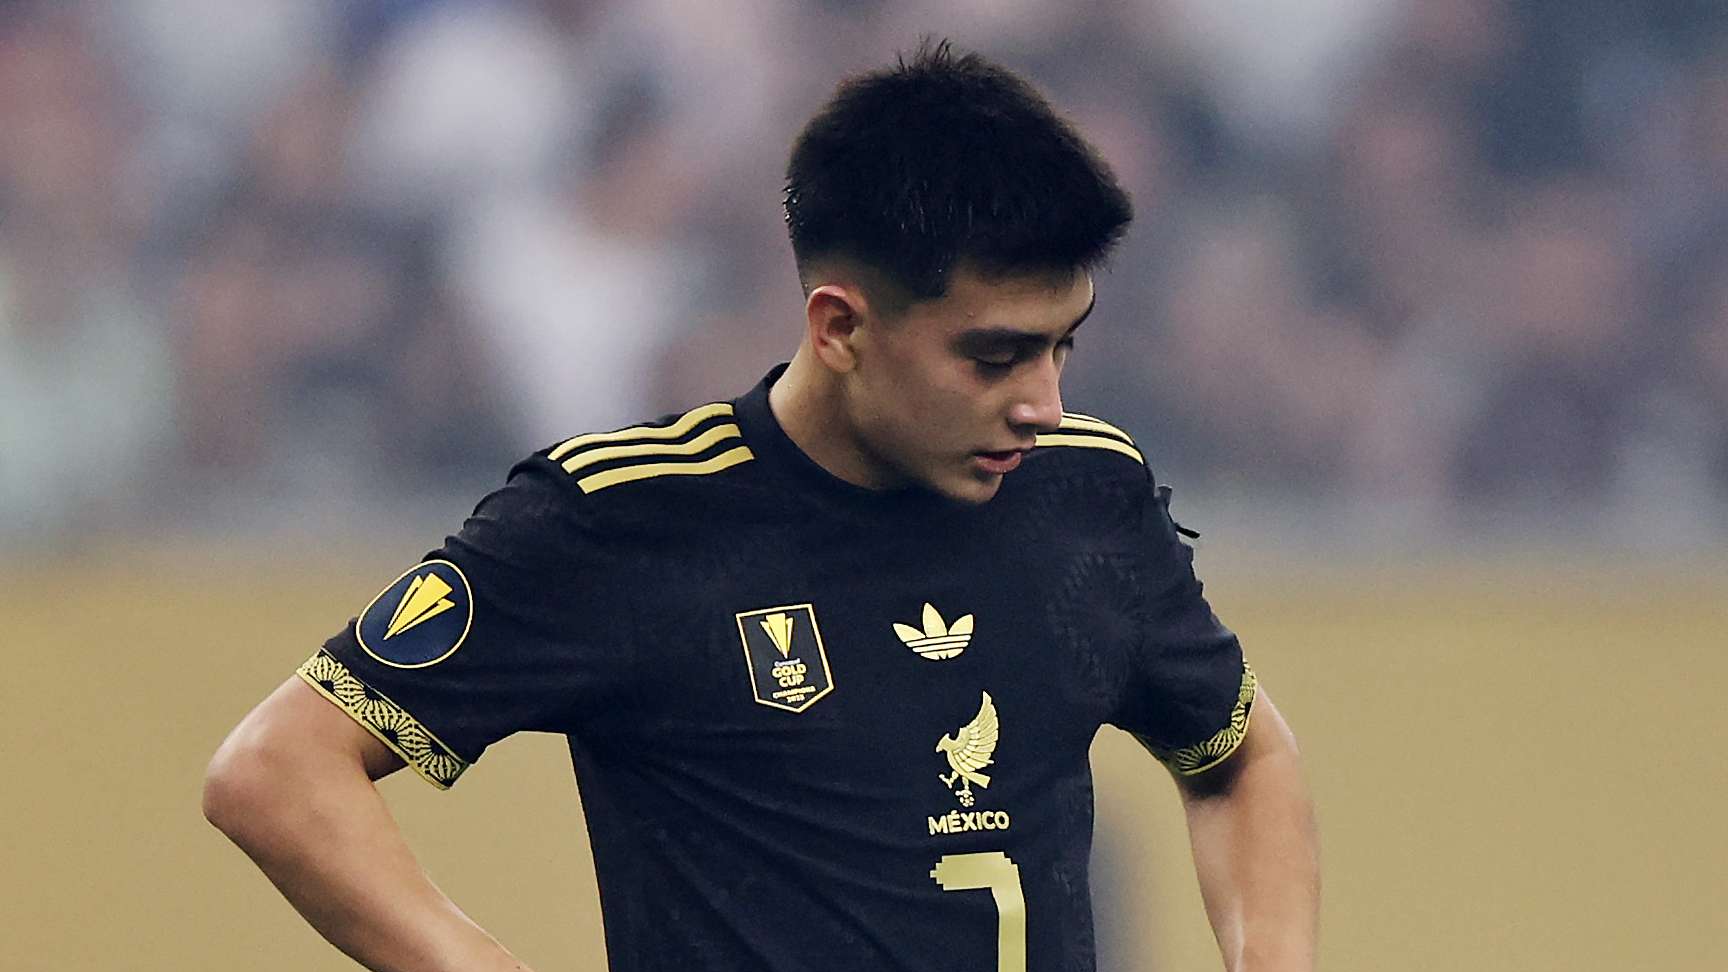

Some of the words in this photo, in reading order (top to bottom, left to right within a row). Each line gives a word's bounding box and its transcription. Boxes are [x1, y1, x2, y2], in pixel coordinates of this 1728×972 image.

[772, 663, 807, 678] GOLD
[778, 674, 805, 688] CUP
[927, 810, 1010, 835] MÉXICO
